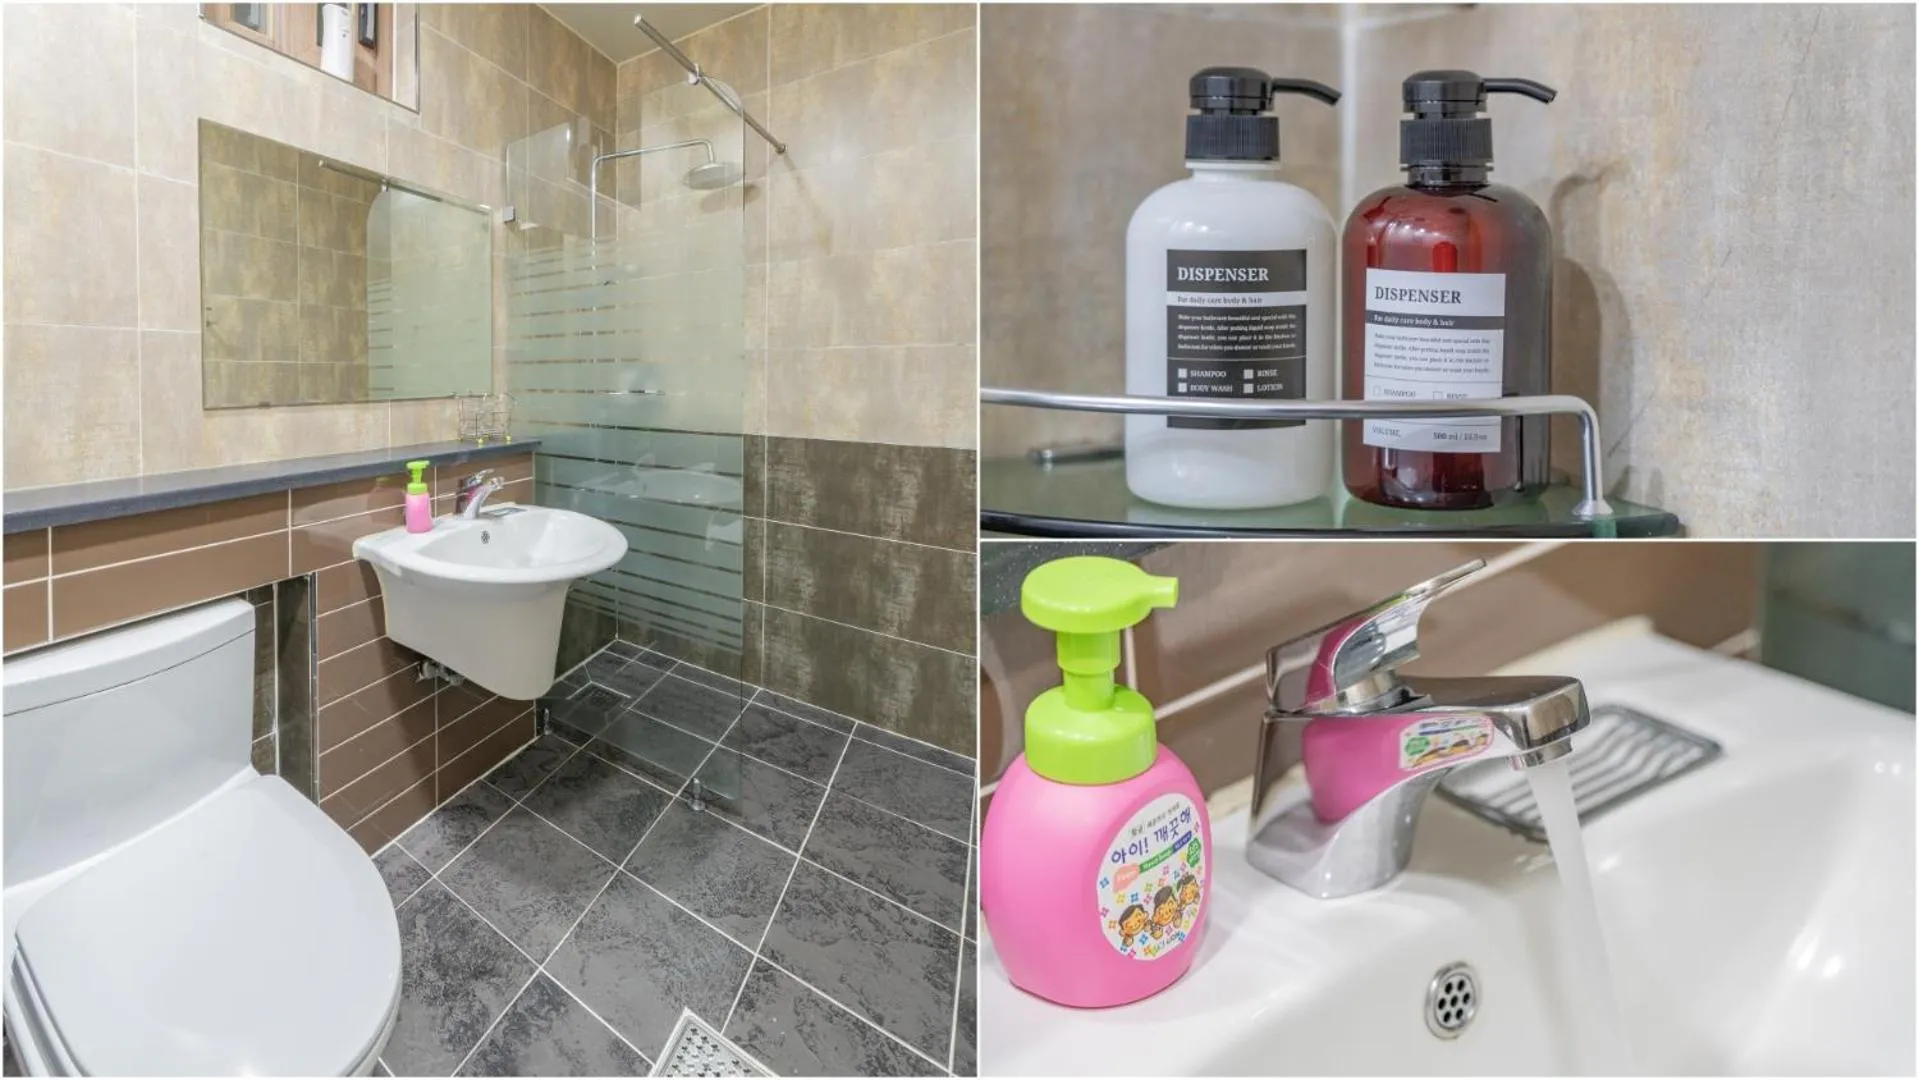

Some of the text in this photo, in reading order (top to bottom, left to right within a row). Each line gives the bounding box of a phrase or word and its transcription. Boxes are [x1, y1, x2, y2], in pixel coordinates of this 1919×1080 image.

[1177, 266, 1269, 282] DISPENSER
[1375, 286, 1462, 304] DISPENSER
[1190, 370, 1227, 378] SHAMPOO
[1210, 384, 1233, 393] WASH
[1111, 836, 1149, 865] 아이!
